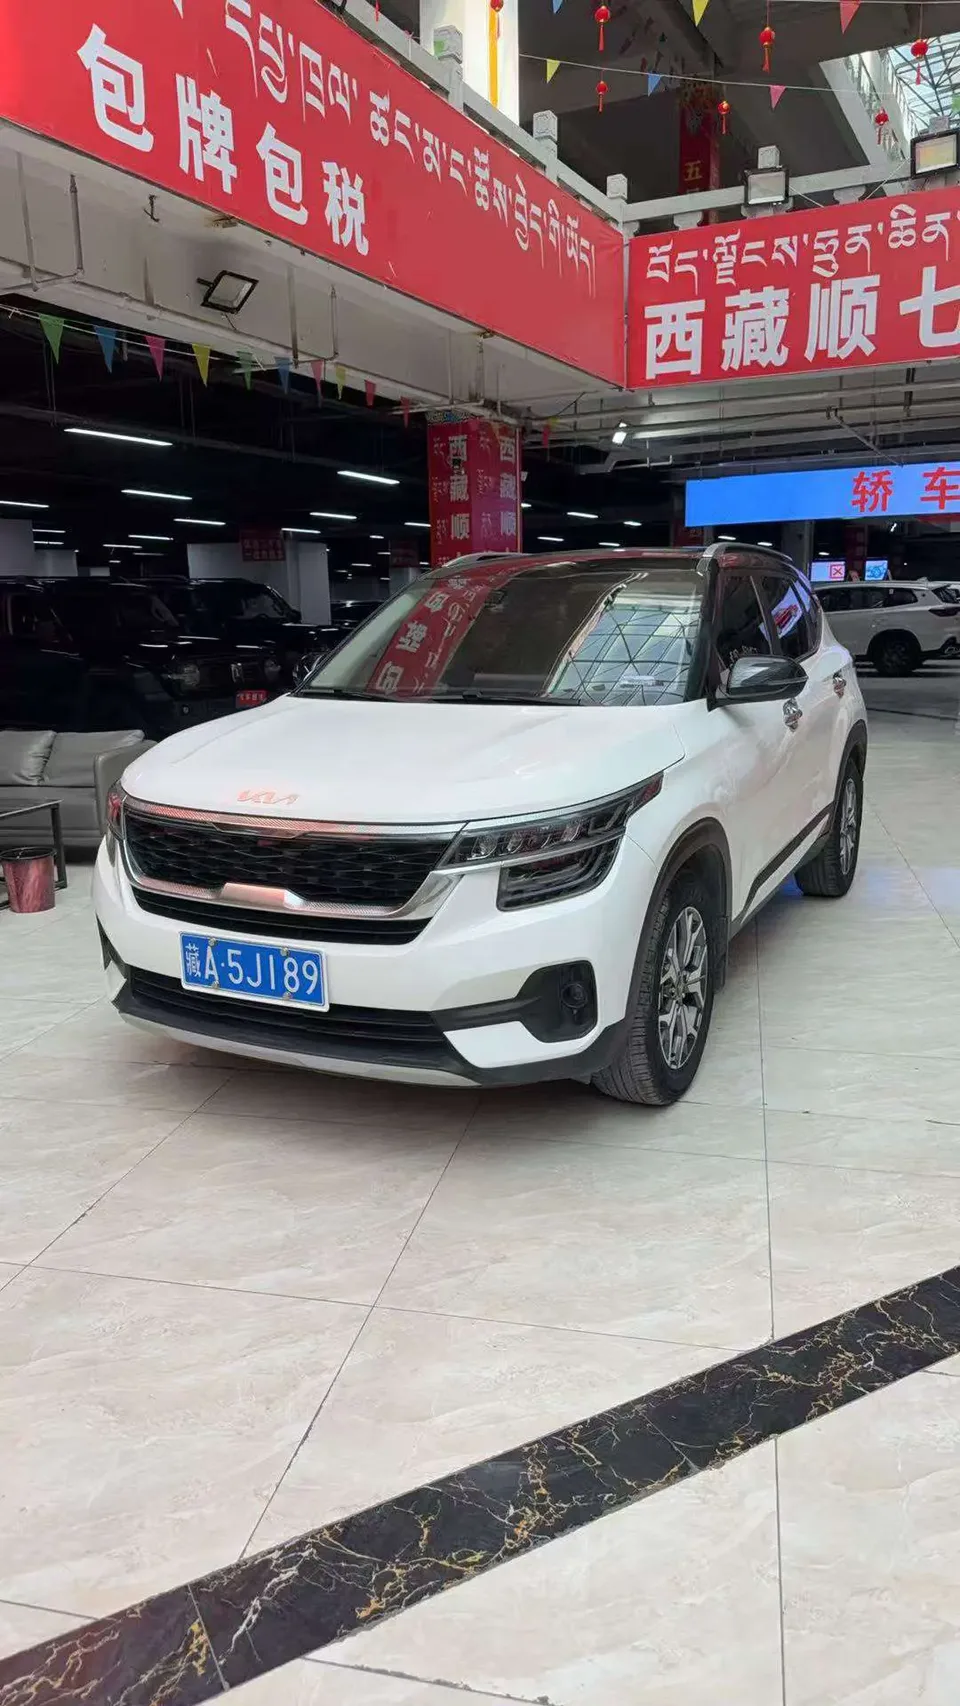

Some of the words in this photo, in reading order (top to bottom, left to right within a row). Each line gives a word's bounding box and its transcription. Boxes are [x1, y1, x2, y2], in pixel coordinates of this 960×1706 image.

[77, 24, 369, 256] 包牌包税
[645, 266, 960, 380] 西藏顺七
[448, 434, 470, 556] 西藏顺
[500, 434, 517, 552] 西藏顺
[851, 466, 960, 513] 轿车
[236, 789, 300, 805] KIA
